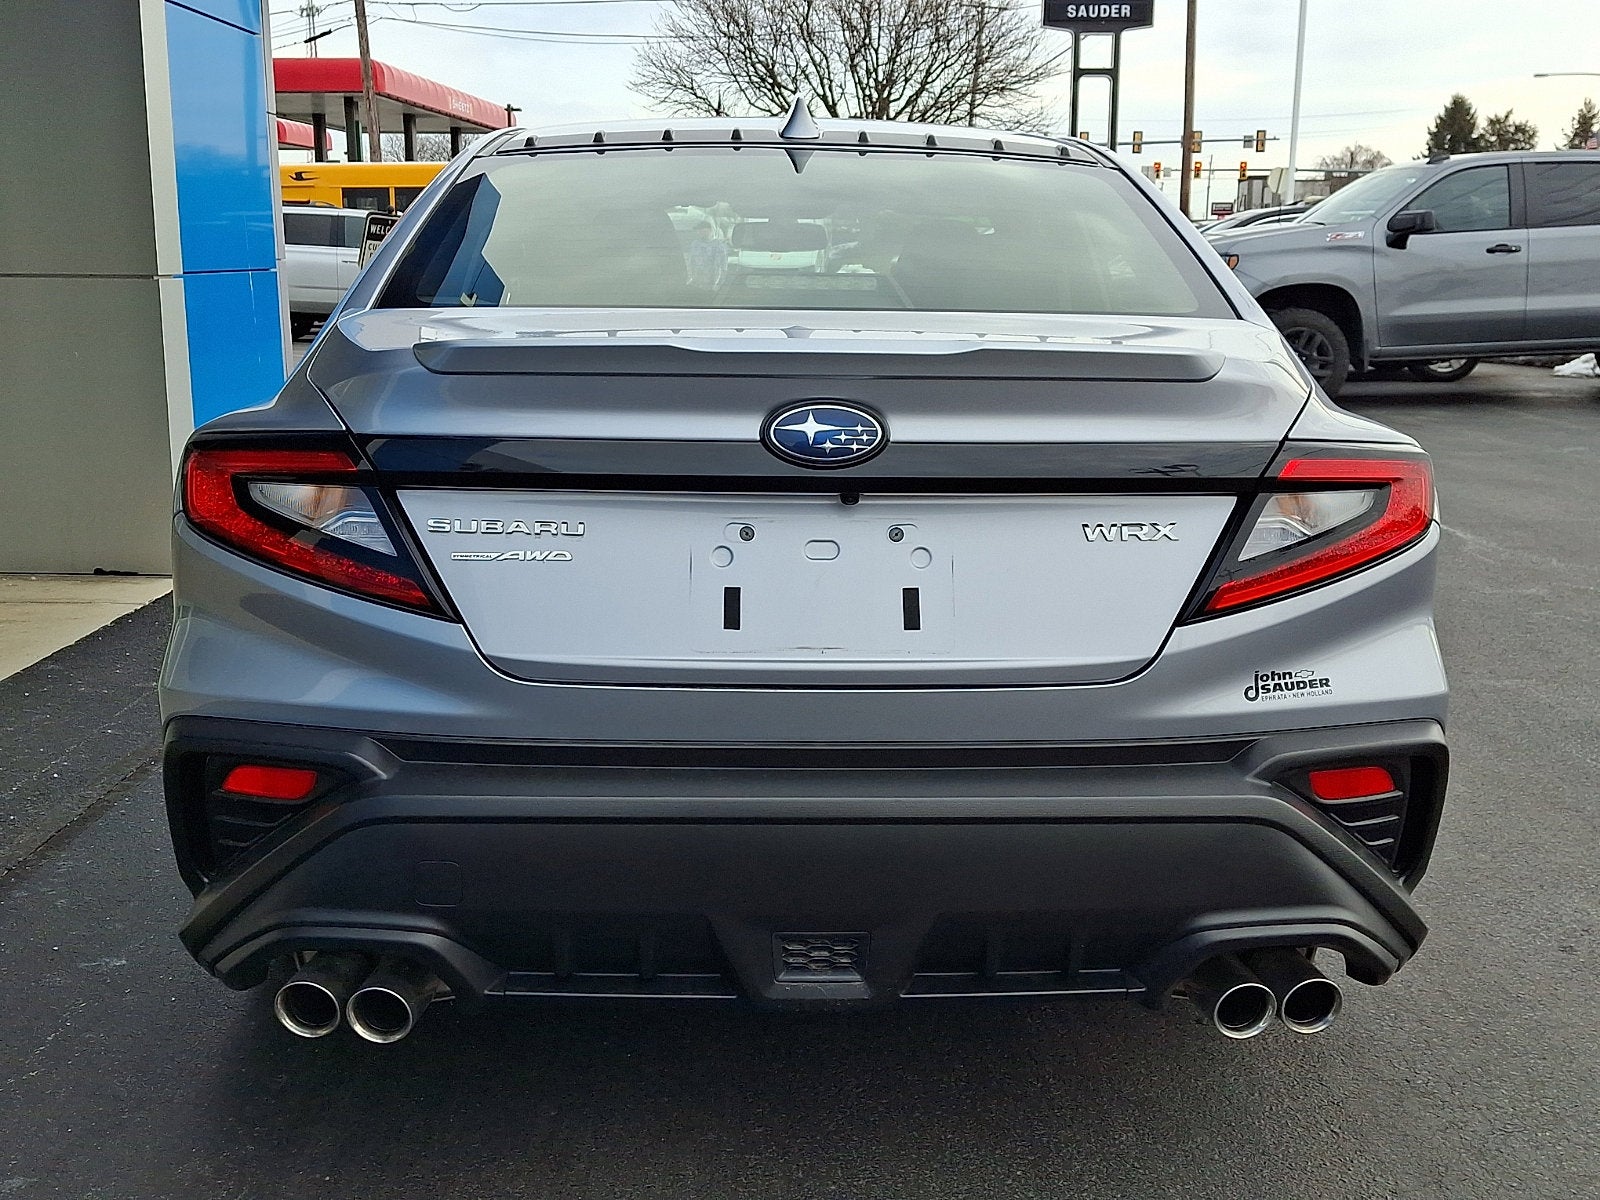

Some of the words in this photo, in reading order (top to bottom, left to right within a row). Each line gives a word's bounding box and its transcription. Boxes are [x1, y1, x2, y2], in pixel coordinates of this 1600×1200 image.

[1066, 4, 1131, 18] SAUDER
[427, 518, 586, 536] SUBARU
[1081, 522, 1179, 542] WRX
[498, 550, 573, 561] AWD
[1260, 678, 1331, 694] SAUDER
[1261, 693, 1288, 702] EPHRATA
[1292, 691, 1305, 699] NEW
[1306, 688, 1333, 698] HOLLAND
